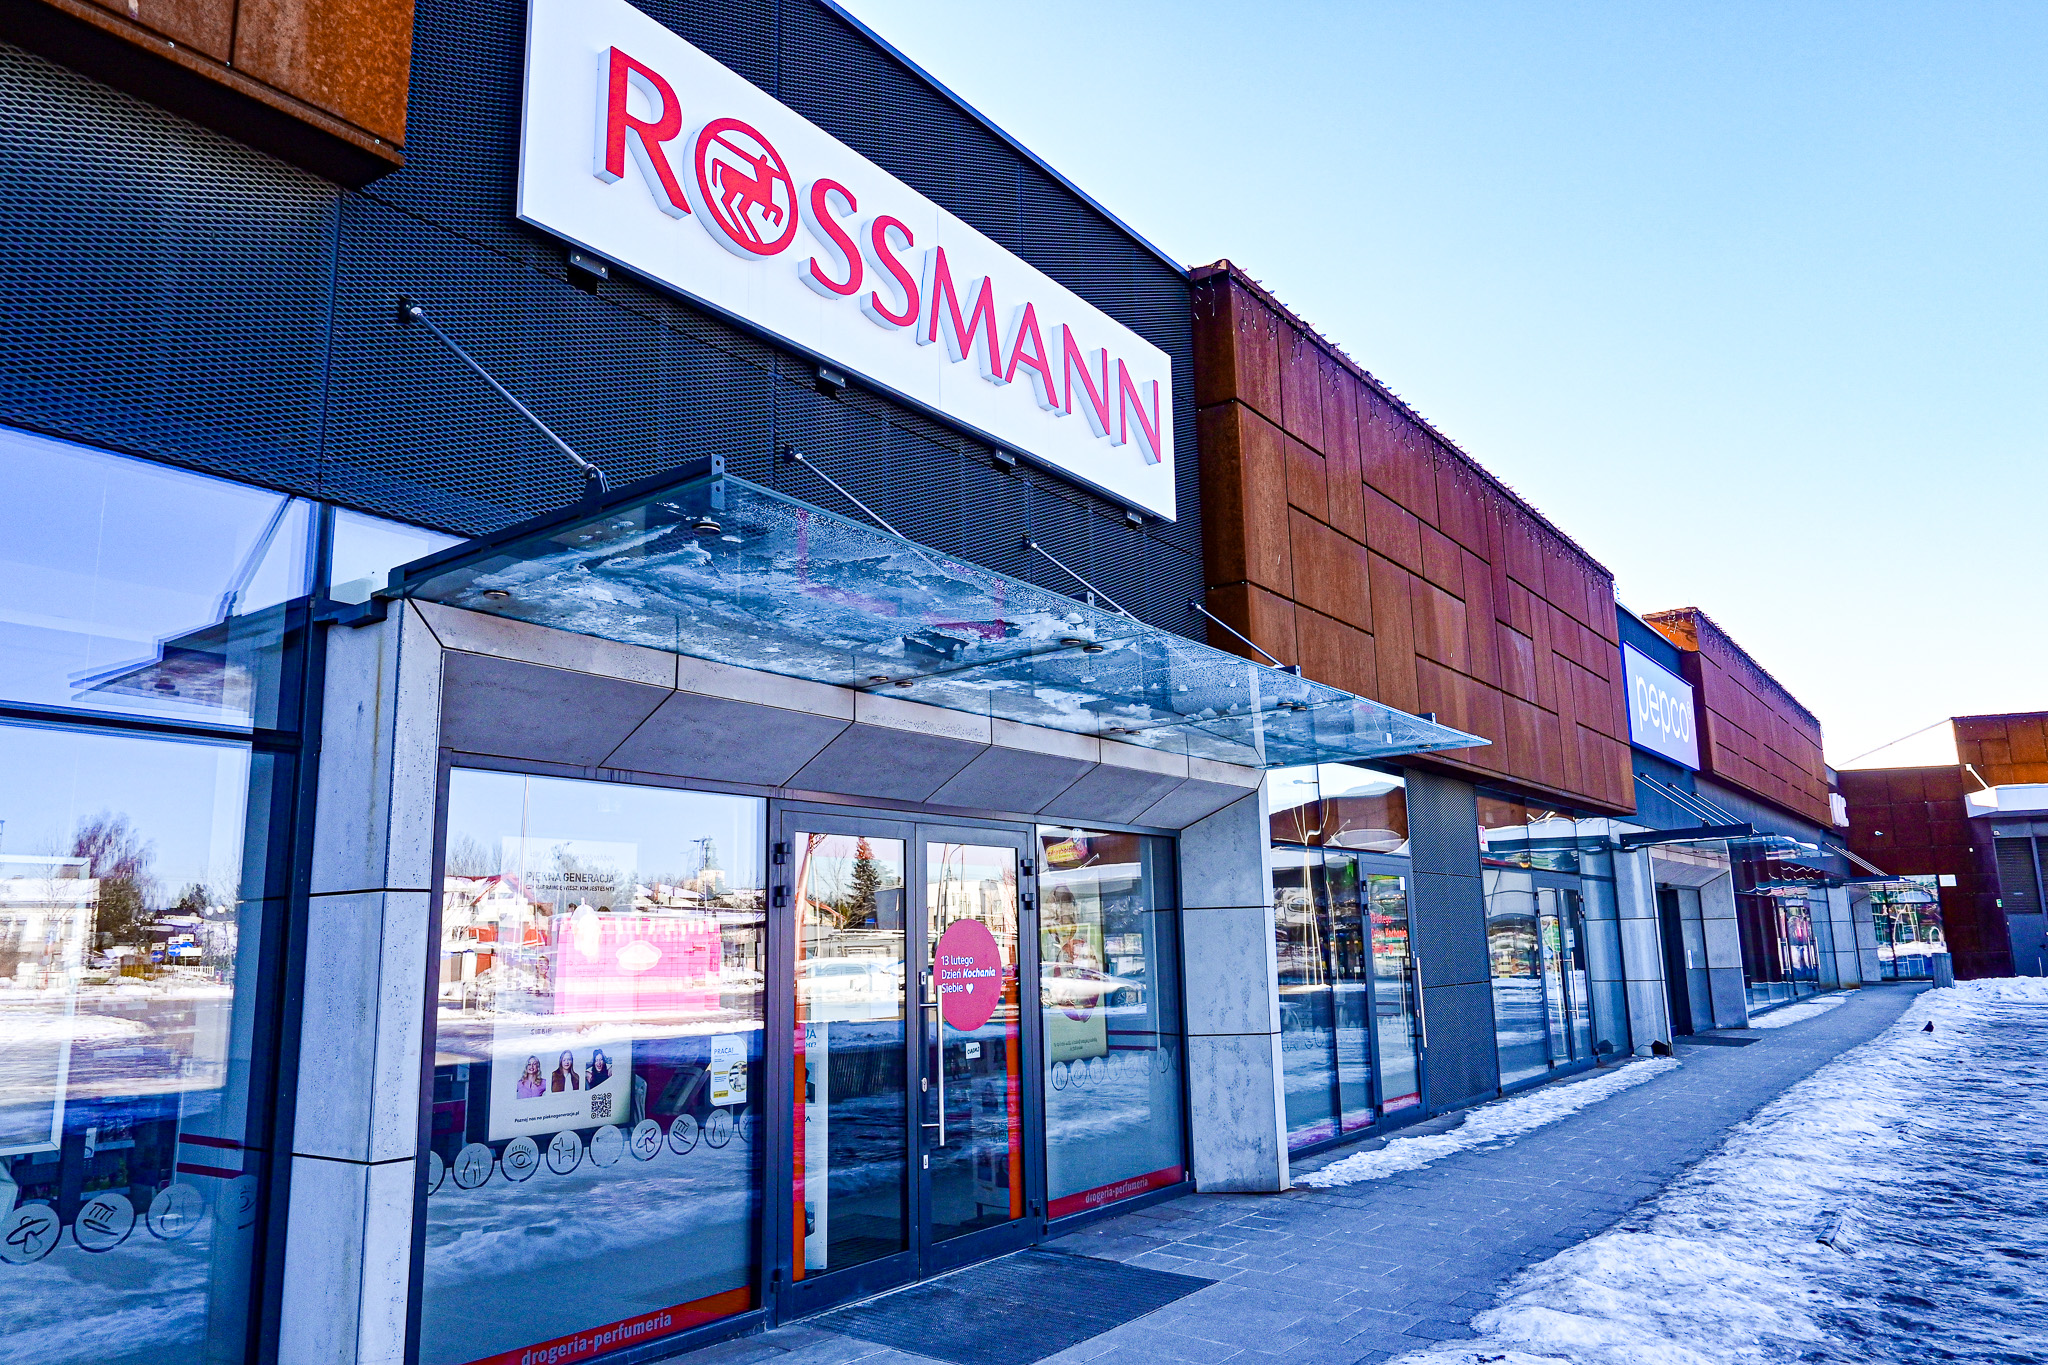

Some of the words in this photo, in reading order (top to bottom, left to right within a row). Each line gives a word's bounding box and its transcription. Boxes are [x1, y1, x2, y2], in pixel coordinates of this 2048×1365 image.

[594, 46, 1161, 465] ROSSMANN
[563, 872, 615, 884] GENERACJA
[941, 956, 949, 966] 13
[951, 955, 974, 967] lutego
[941, 968, 961, 979] Dzień
[962, 966, 997, 978] Kochania
[941, 983, 963, 994] Siebie
[714, 1047, 734, 1055] PRACA!
[1085, 1177, 1149, 1204] drogeria-perfumeria
[521, 1312, 672, 1365] drogeria-perfumeria
